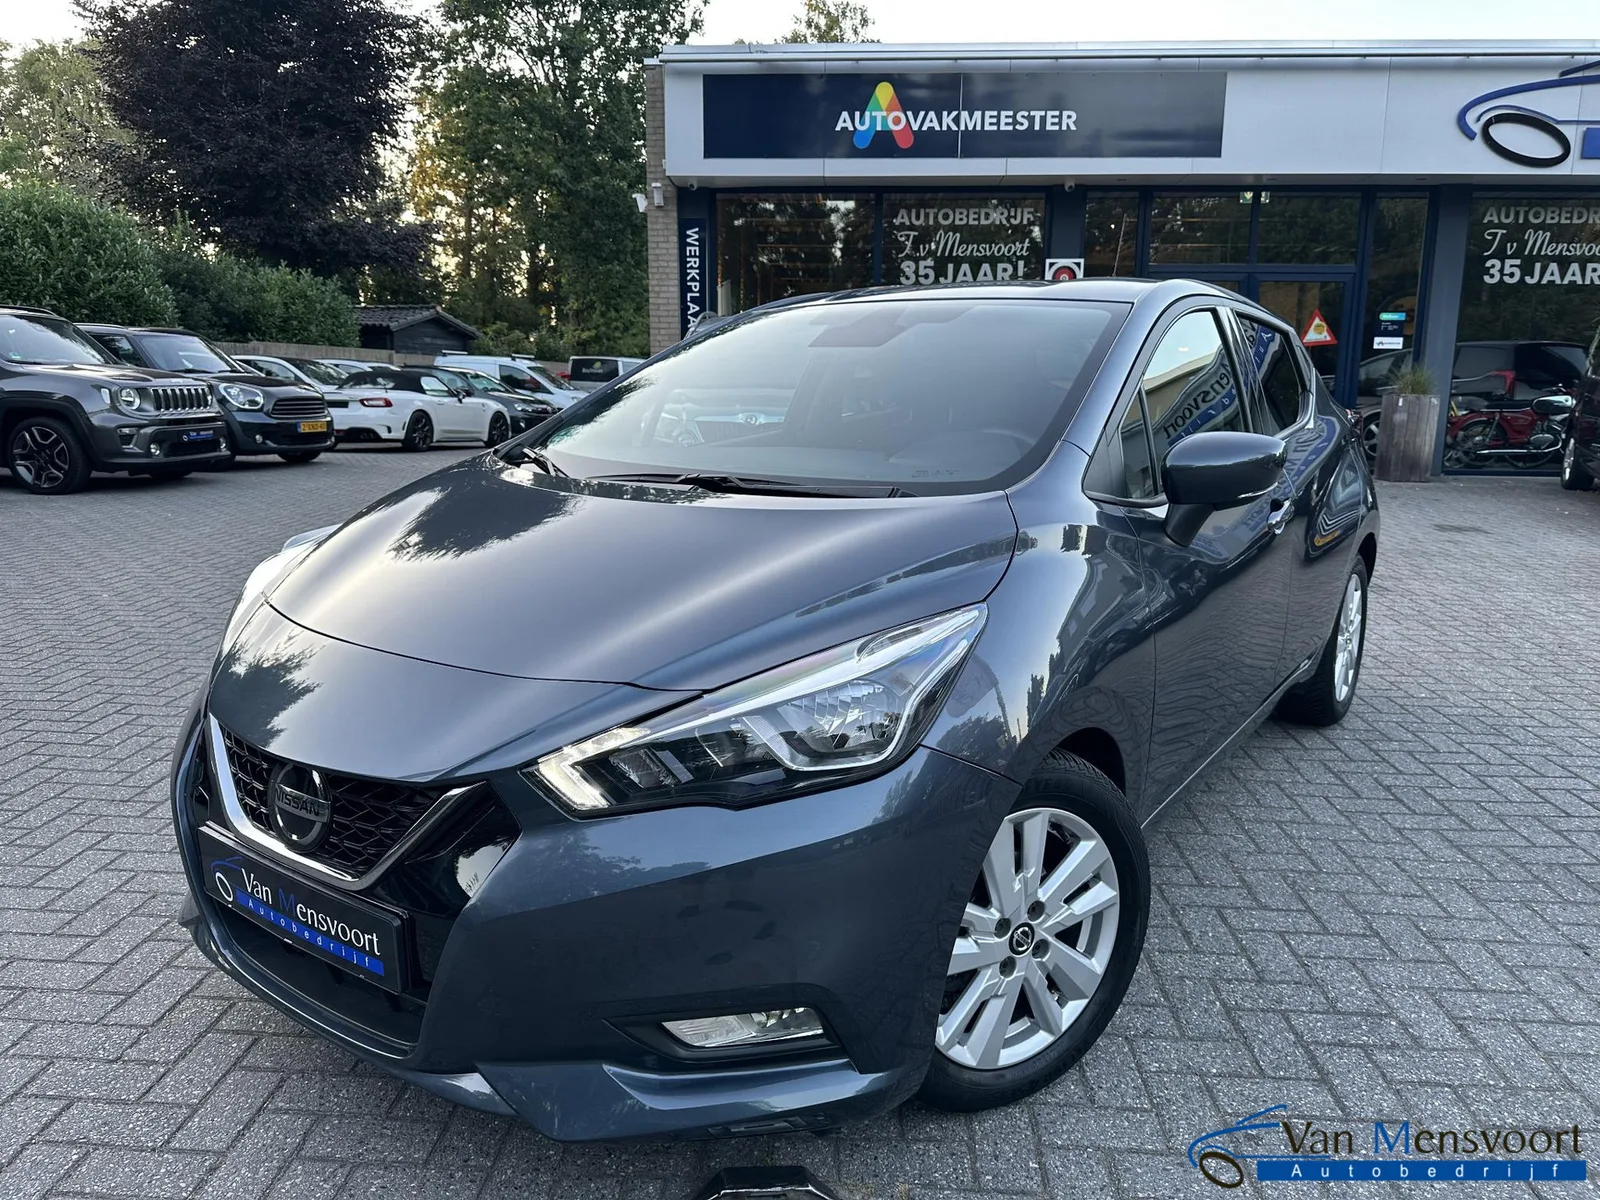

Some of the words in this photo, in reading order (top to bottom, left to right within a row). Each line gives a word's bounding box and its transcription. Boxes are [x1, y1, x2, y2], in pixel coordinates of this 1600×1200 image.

[834, 110, 1078, 132] AUTOVAKMEESTER
[895, 207, 1035, 226] AUTOBEDRIJF
[936, 229, 1031, 257] Mensvoort
[899, 260, 935, 285] 35
[1483, 258, 1521, 284] 35
[274, 785, 319, 816] NISSAN
[241, 868, 273, 905] Van
[279, 887, 381, 956] Mensvoort
[248, 898, 371, 968] Autobedrijf
